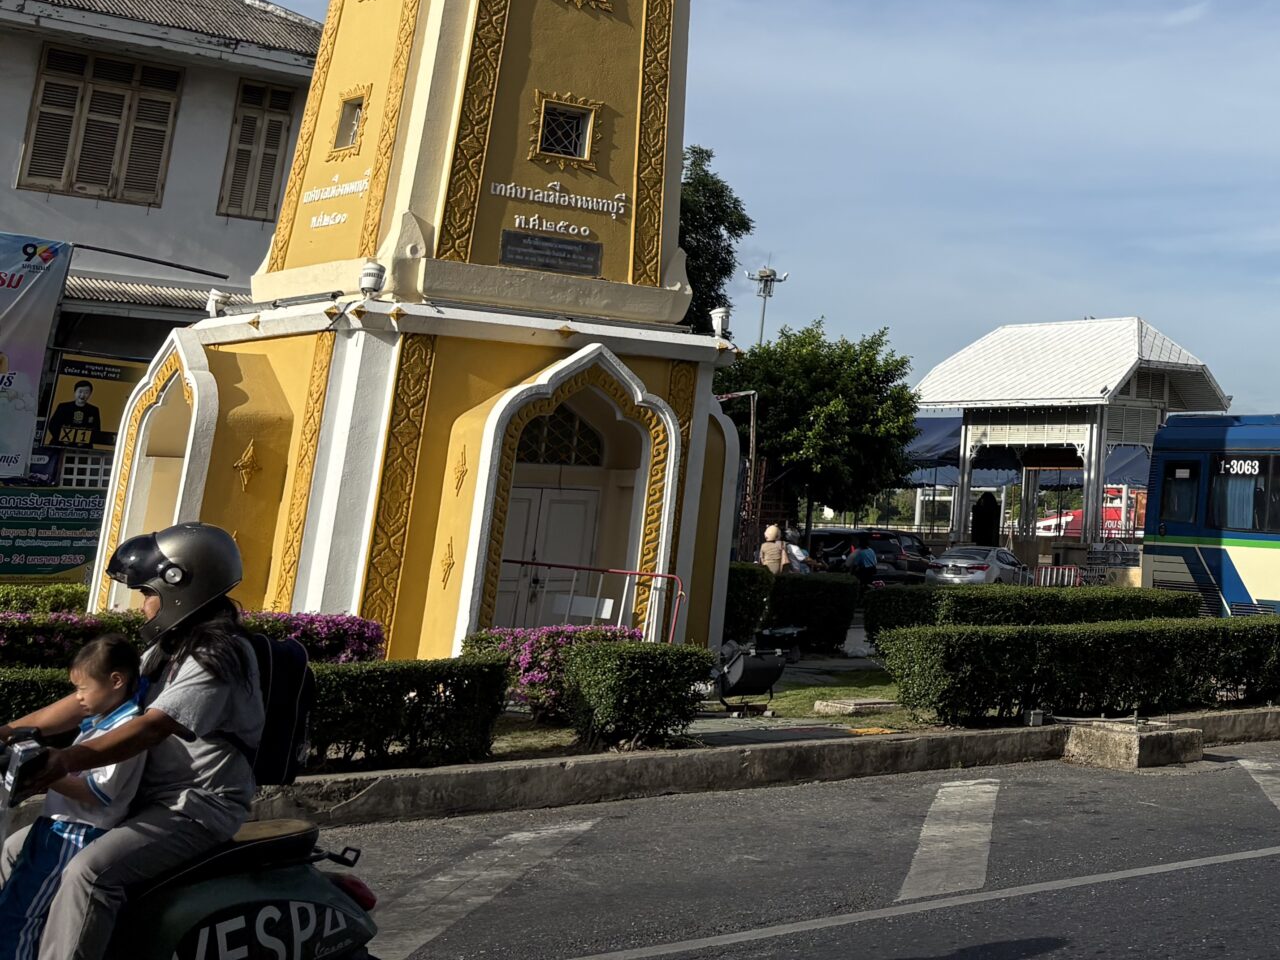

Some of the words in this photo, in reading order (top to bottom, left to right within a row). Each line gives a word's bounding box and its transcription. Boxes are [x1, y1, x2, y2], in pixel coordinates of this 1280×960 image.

[490, 181, 627, 220] เทศบาลเมืองนนทบุรี
[513, 213, 591, 237] พ.ศ.๒๕๐๐
[1219, 459, 1260, 475] 1-3063
